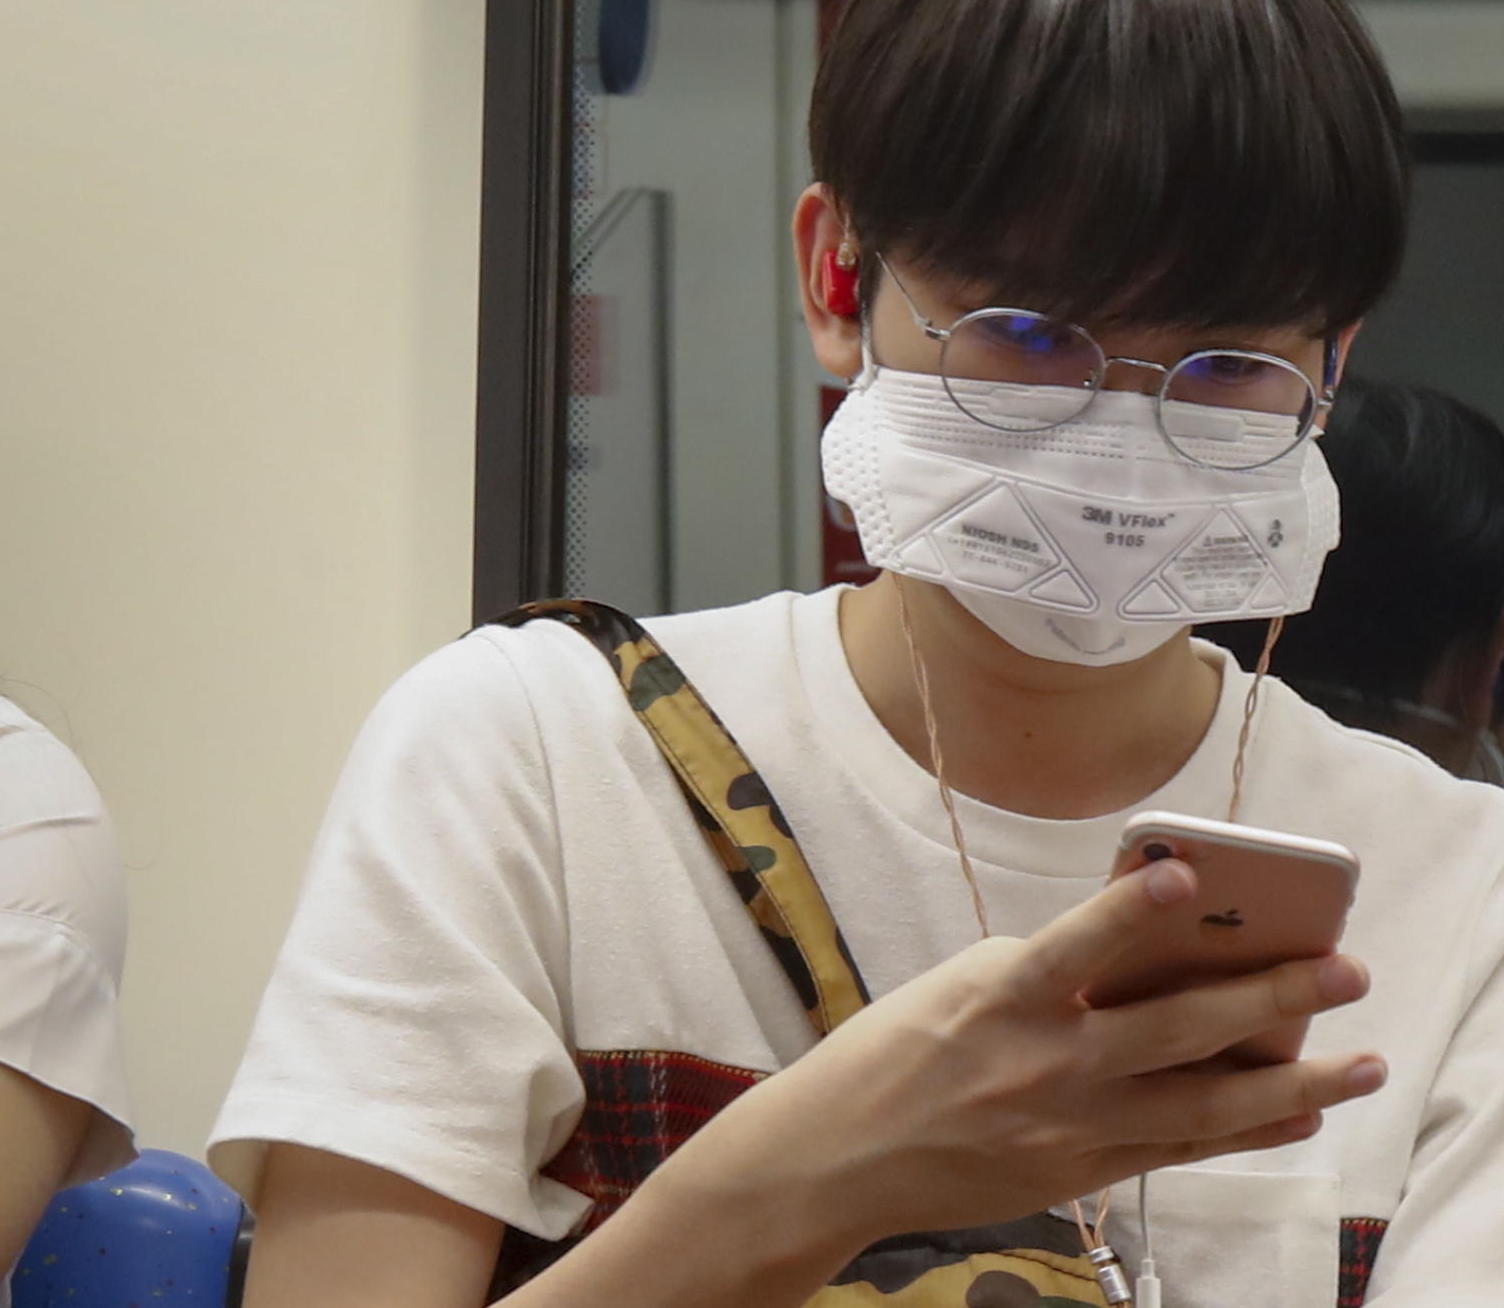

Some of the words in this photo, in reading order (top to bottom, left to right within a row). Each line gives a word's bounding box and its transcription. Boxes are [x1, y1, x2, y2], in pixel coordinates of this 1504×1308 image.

[1082, 506, 1113, 525] 3M
[961, 525, 1007, 546] NIOSH
[1105, 532, 1145, 547] 9105
